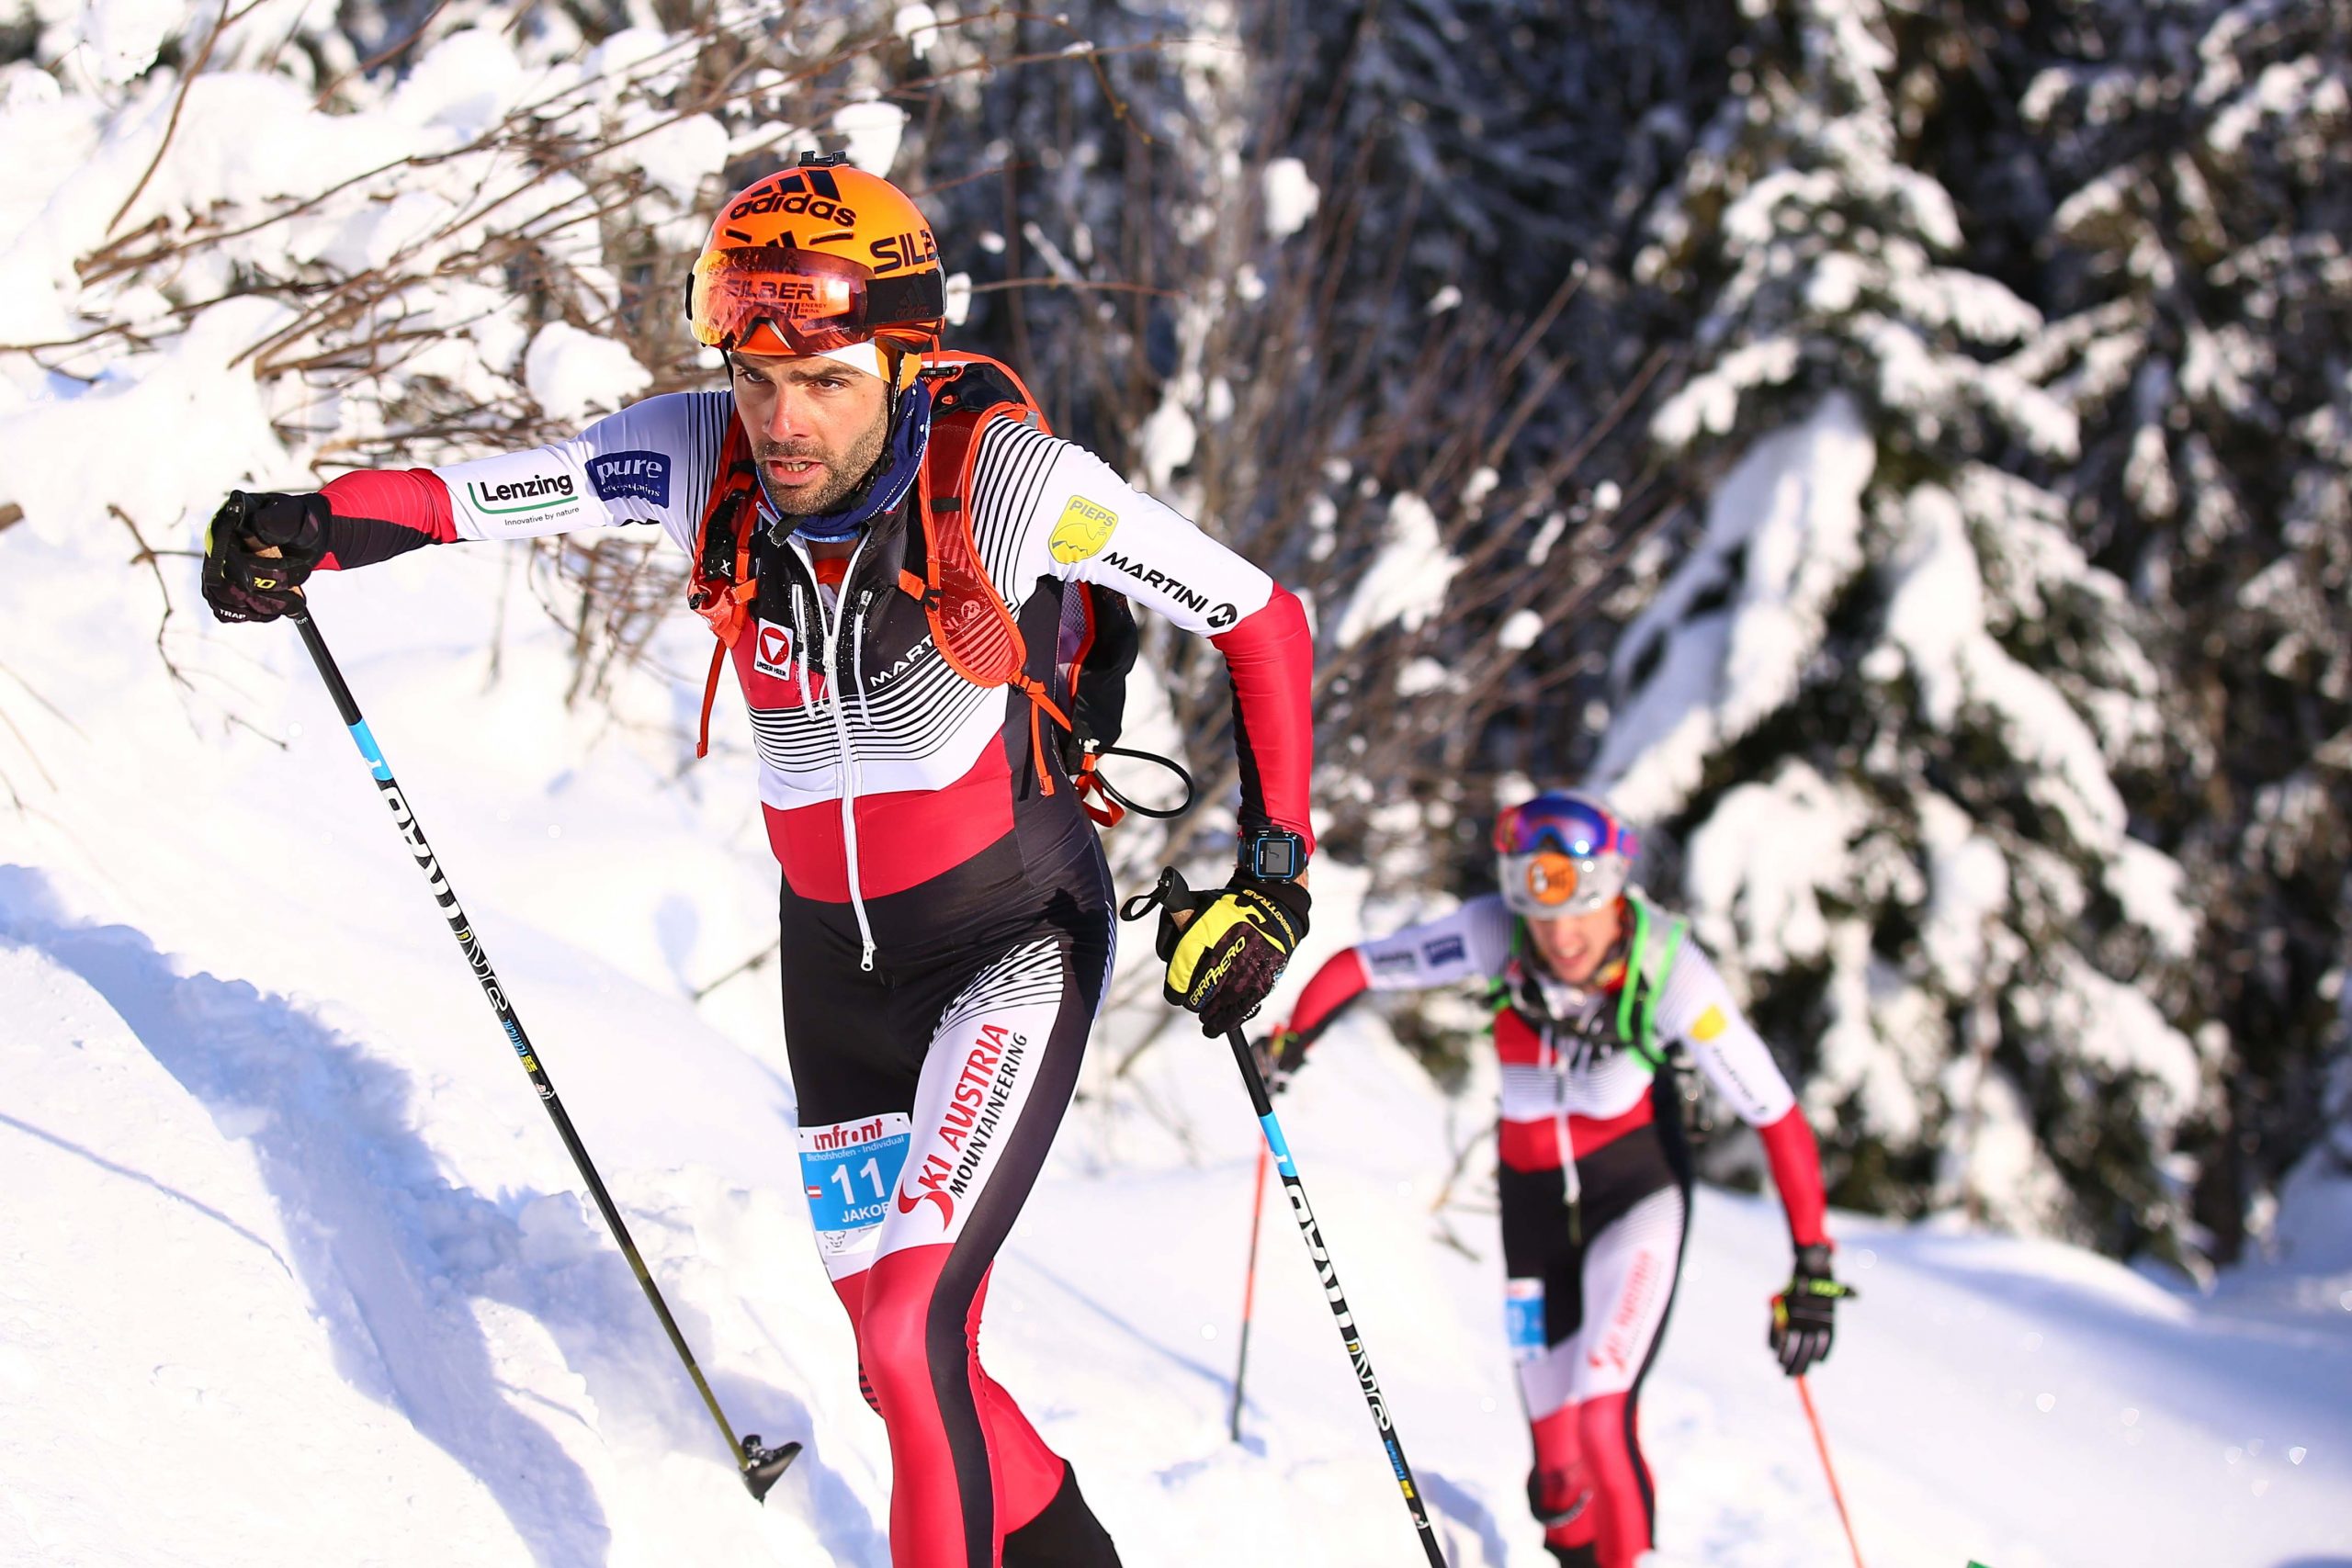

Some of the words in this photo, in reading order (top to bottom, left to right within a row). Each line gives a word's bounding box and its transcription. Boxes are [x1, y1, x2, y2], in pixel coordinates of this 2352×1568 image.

[729, 192, 856, 228] adidas
[480, 474, 573, 502] Lenzing
[596, 459, 663, 485] pure
[504, 515, 544, 526] Innovative
[545, 513, 554, 522] by
[556, 506, 580, 518] nature
[1069, 500, 1115, 527] PIEPS
[1102, 551, 1208, 614] MARTINI
[899, 1154, 955, 1233] SKI
[938, 1023, 1009, 1152] AUSTRIA
[949, 1032, 1028, 1200] MOUNTAINEERING
[806, 1148, 856, 1162] Bischofshofen
[862, 1134, 905, 1153] Individual
[831, 1157, 886, 1205] 11
